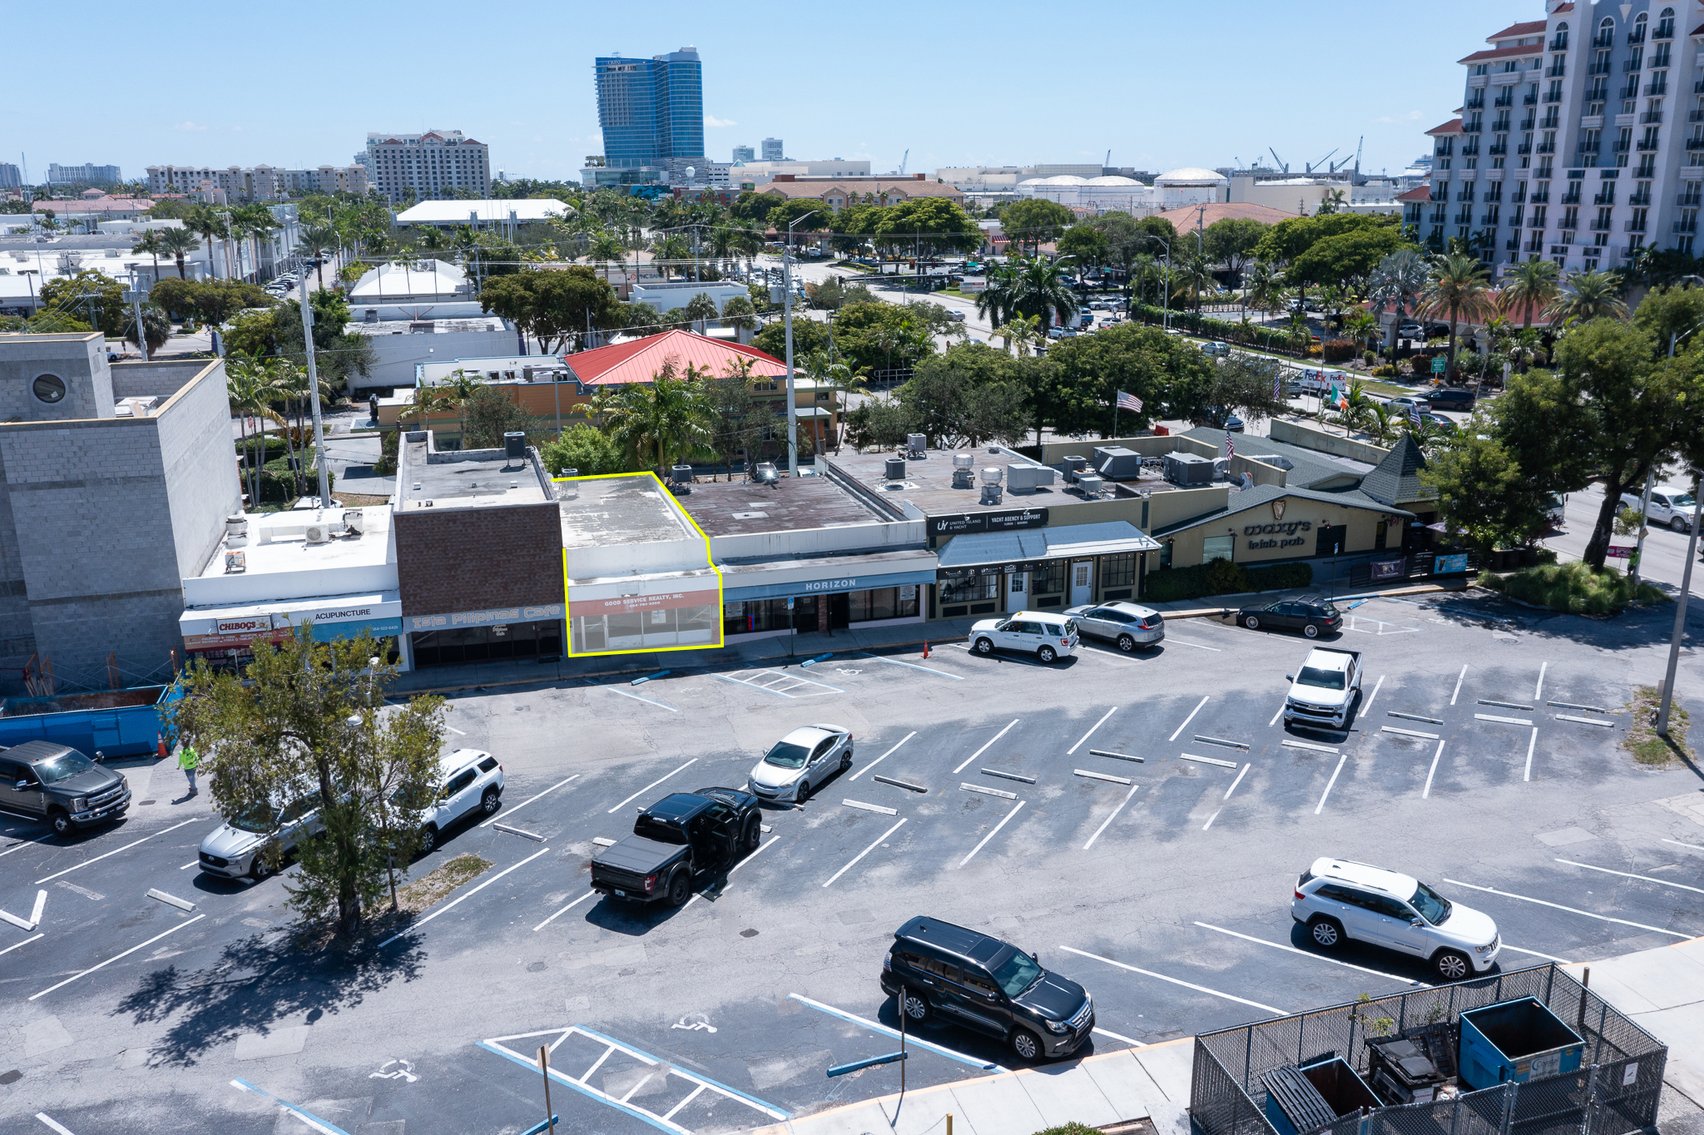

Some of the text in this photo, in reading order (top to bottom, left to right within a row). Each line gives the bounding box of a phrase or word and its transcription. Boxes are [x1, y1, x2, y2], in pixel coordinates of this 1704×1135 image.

[1304, 369, 1326, 382] FedEx
[805, 578, 856, 591] HORIZON
[623, 597, 647, 605] SERVICE
[648, 594, 671, 602] REALTY,
[315, 608, 371, 620] ACUPUNCTURE
[523, 604, 561, 619] Cafe
